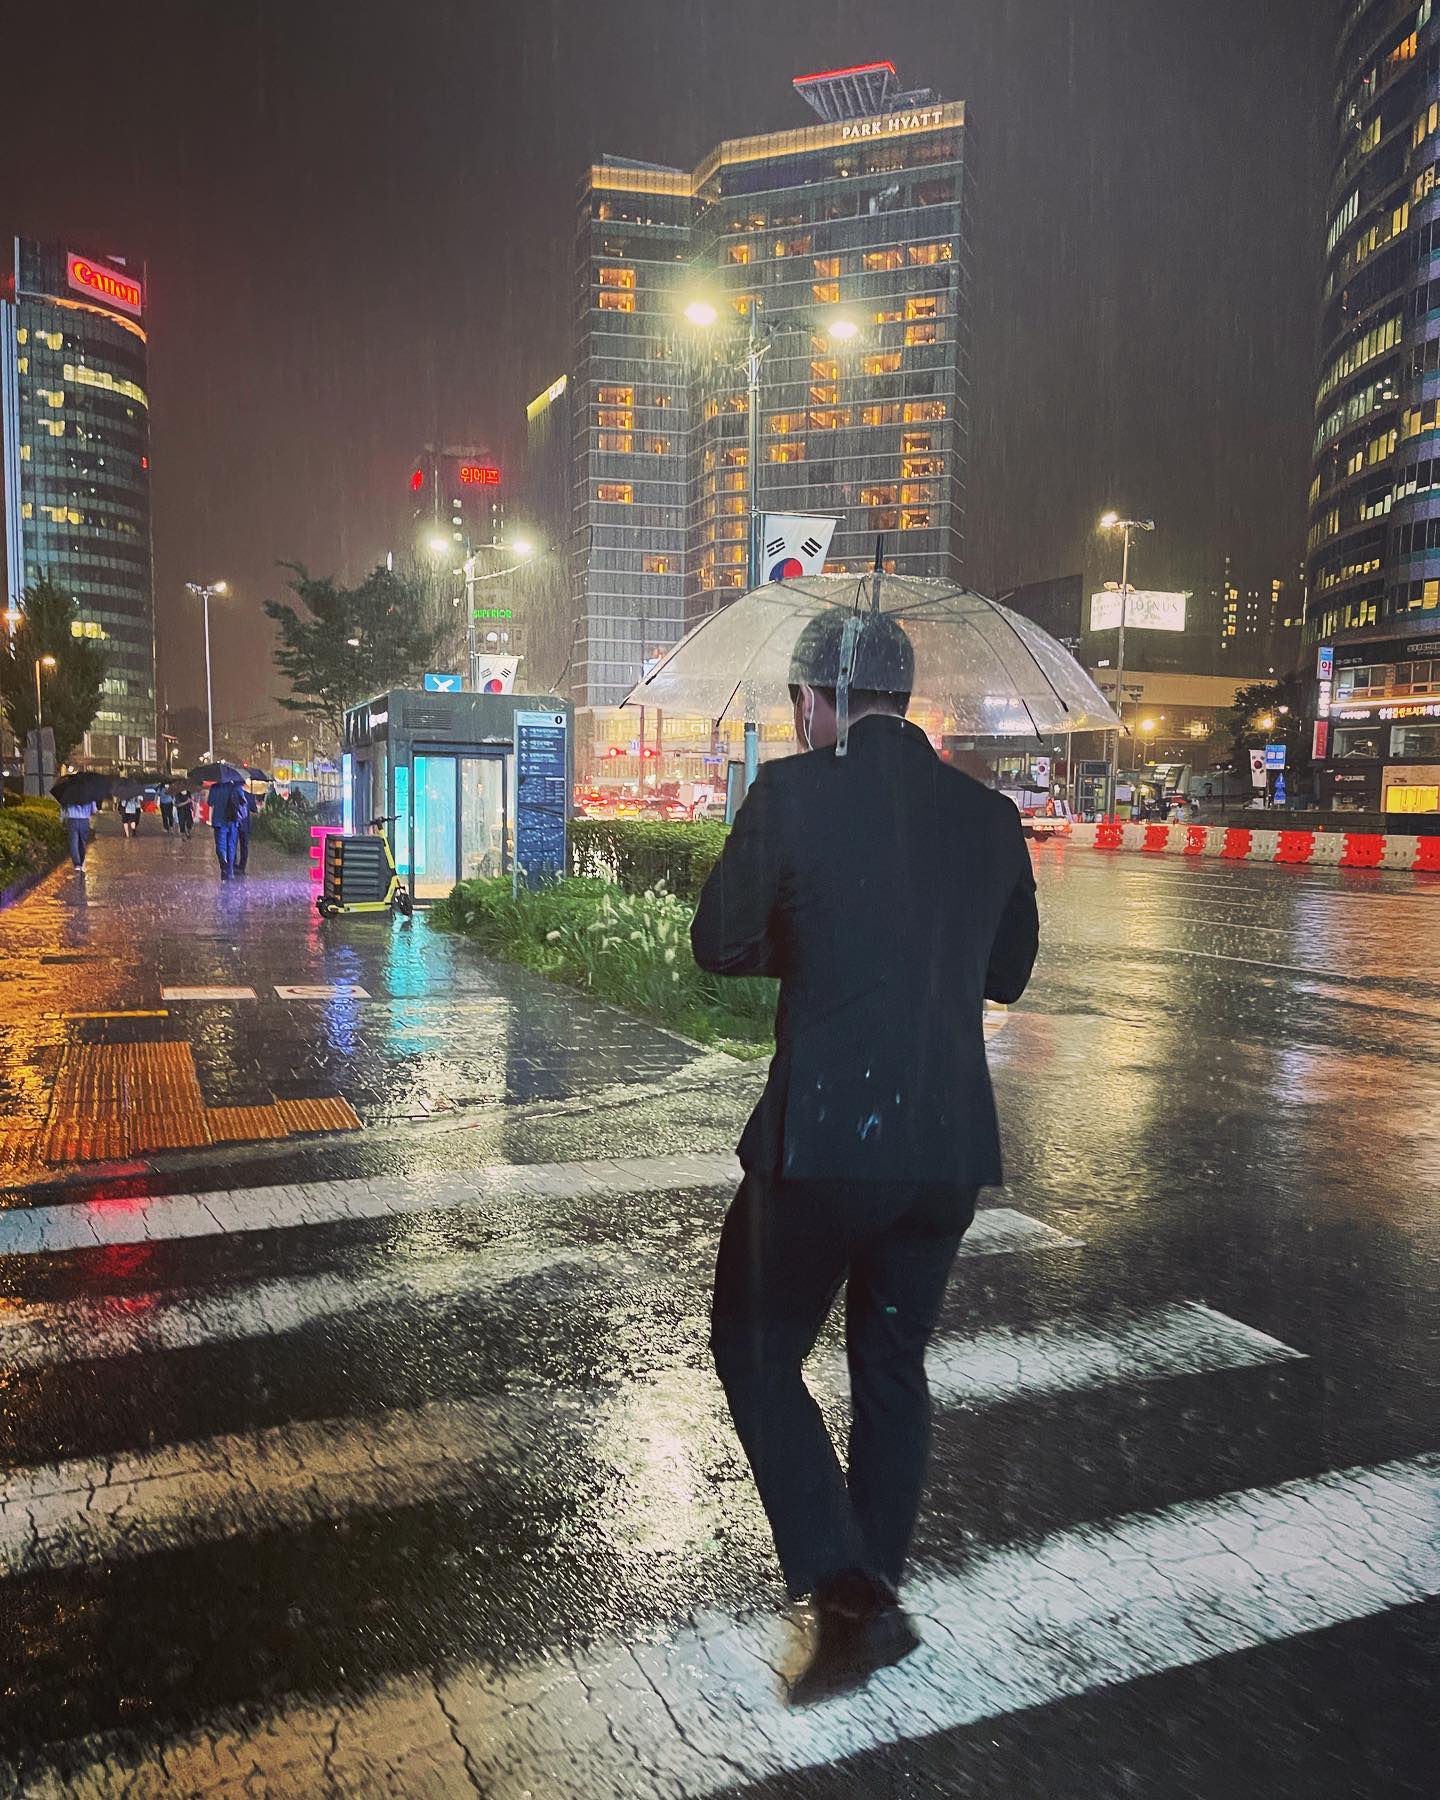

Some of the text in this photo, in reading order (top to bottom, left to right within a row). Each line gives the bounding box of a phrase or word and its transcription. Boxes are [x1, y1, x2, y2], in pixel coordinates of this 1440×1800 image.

[842, 111, 943, 139] PARK HYATT
[73, 261, 139, 306] Canon
